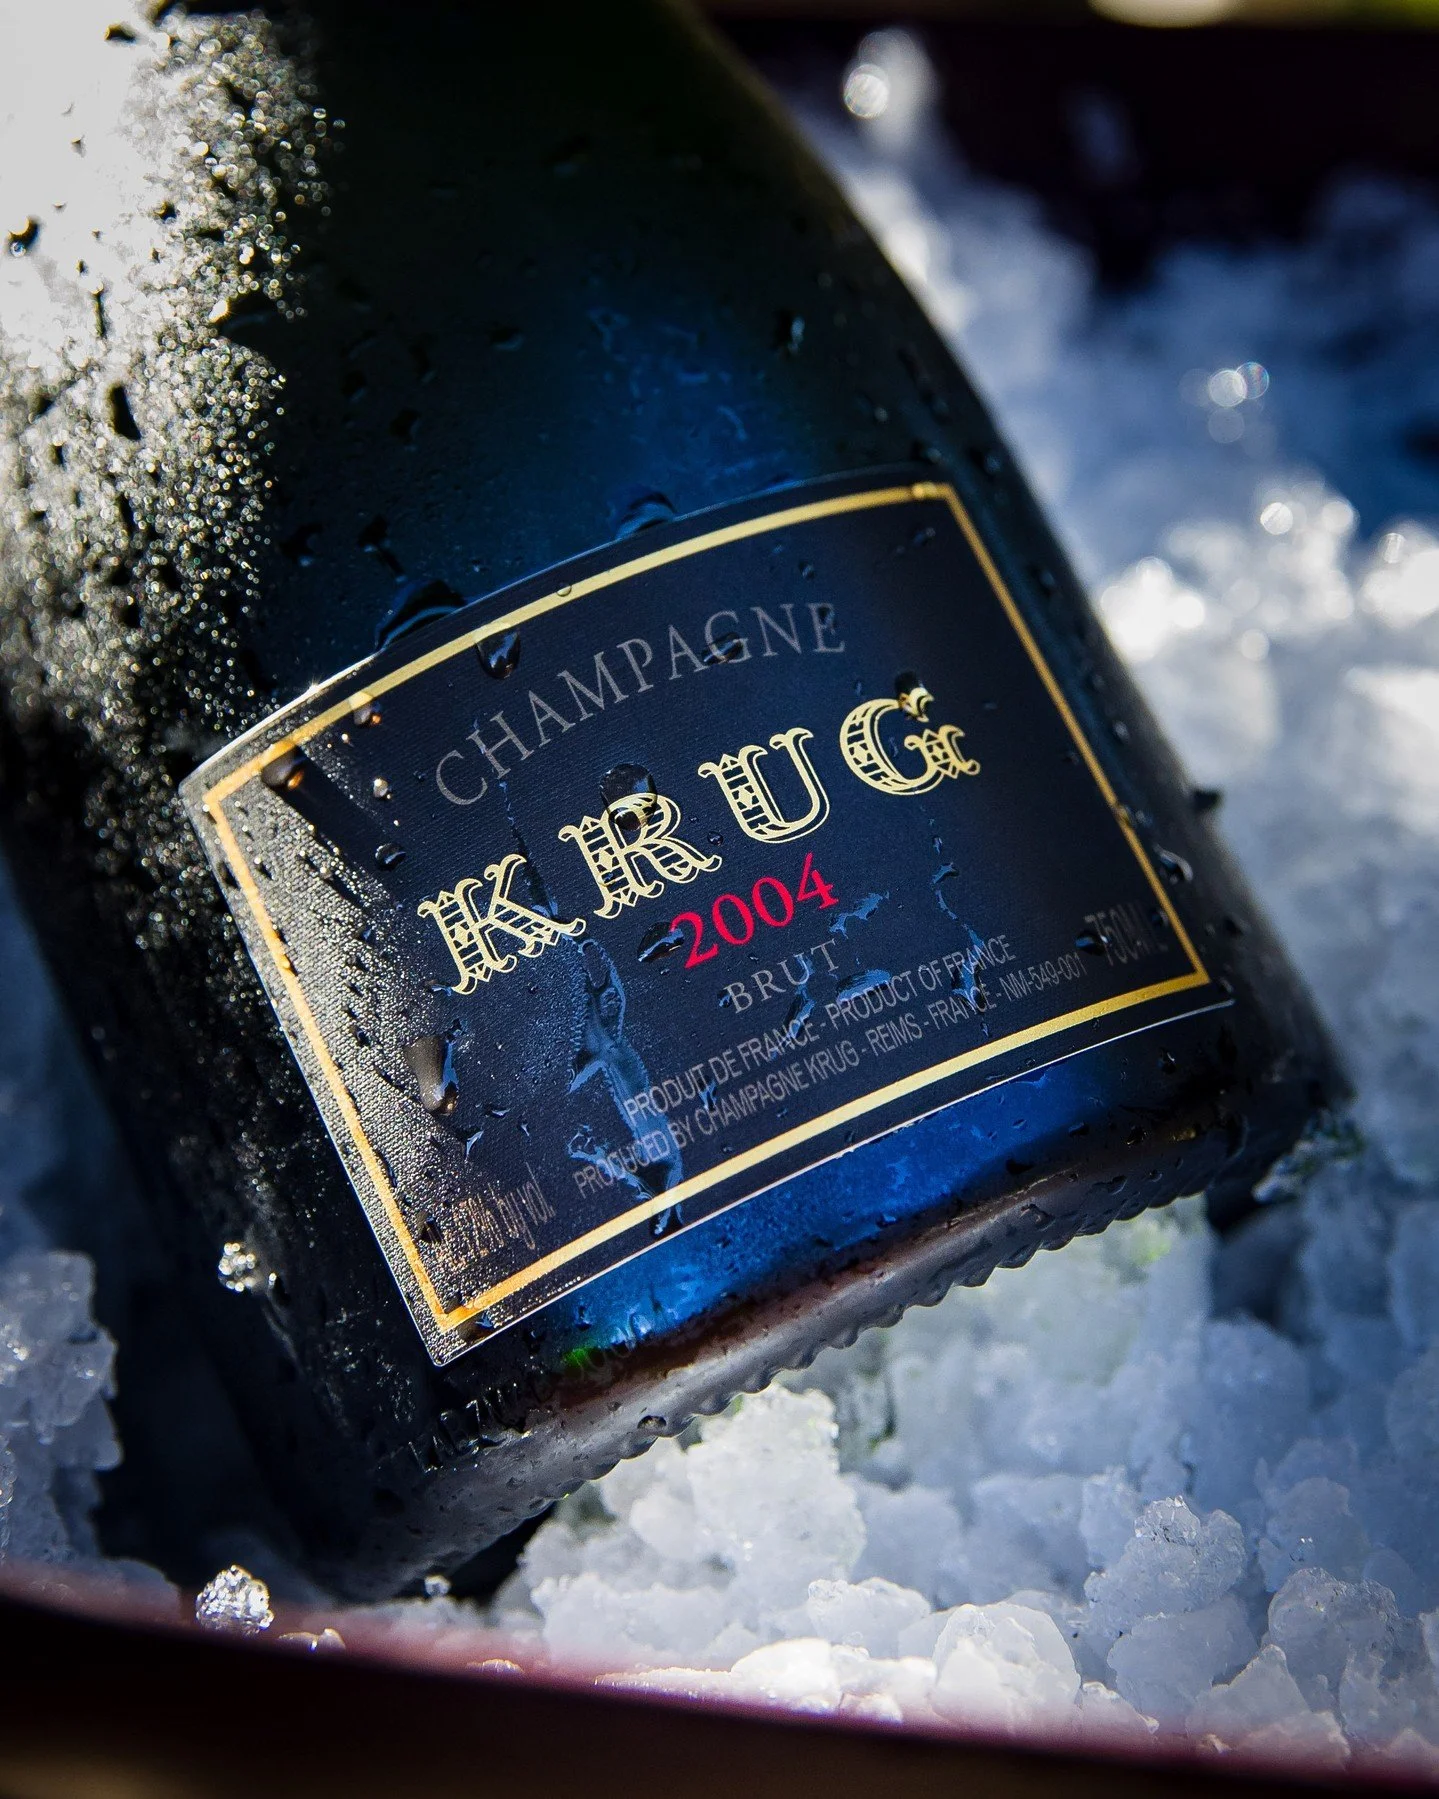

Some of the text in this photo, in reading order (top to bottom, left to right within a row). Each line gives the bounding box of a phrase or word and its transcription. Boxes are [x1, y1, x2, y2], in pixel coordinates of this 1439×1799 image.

[435, 602, 847, 807] CHAMPAGNE
[416, 686, 982, 997] KRUG
[670, 851, 840, 969] 2004
[624, 1062, 706, 1126] PRODUIT
[707, 1049, 743, 1084] DE
[736, 1012, 821, 1072] FRANCE
[824, 968, 920, 1032] PRODUCT
[916, 958, 947, 992] OF
[941, 934, 1018, 985] FRANCE
[725, 938, 840, 1014] BRUT
[571, 1130, 671, 1199] PRODUCED
[668, 1116, 697, 1149] BY
[694, 1063, 812, 1136] CHAMPAGNE
[803, 1039, 862, 1083] KRUG
[864, 1012, 924, 1057] REIMS
[926, 982, 998, 1028] FRANCE
[999, 951, 1090, 1003] NM-549-001
[486, 1181, 537, 1251] by
[516, 1160, 557, 1227] vol.
